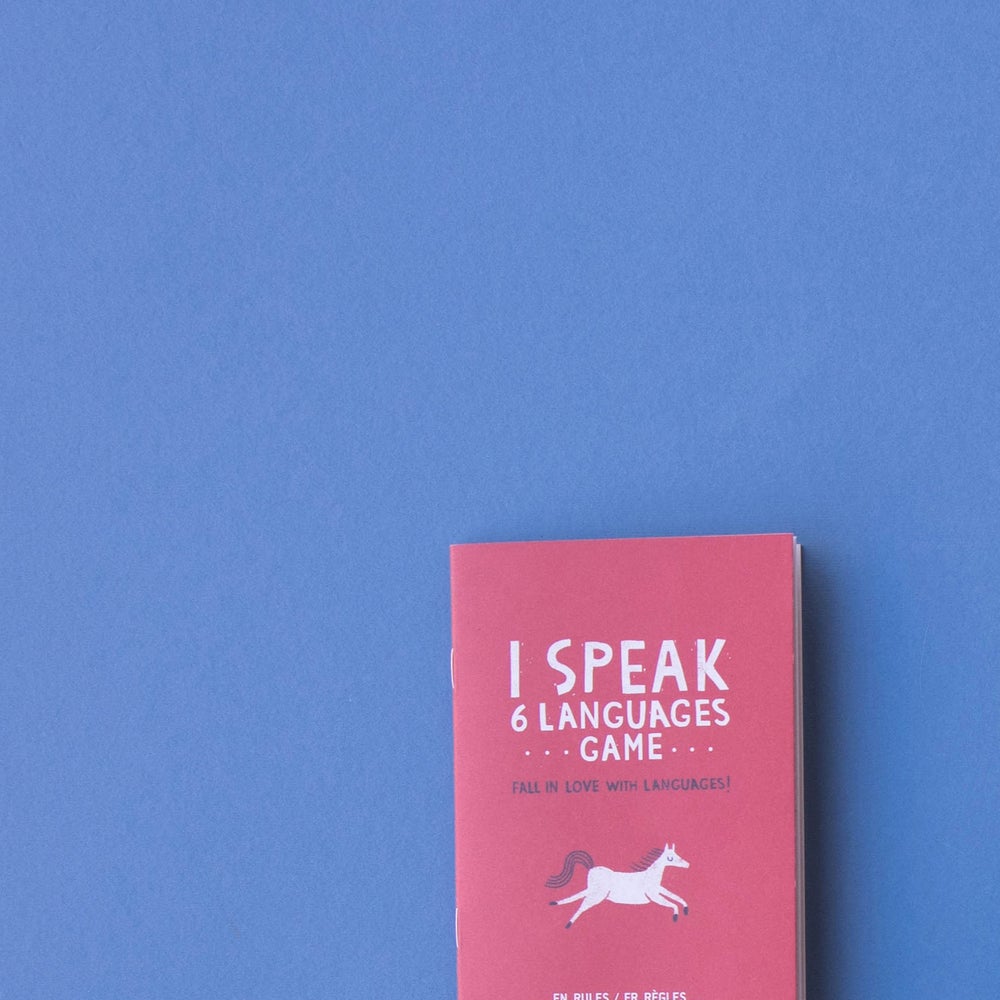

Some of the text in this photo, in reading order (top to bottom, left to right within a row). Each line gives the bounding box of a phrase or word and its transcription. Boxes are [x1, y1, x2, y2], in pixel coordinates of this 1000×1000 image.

[510, 638, 730, 698] I SPEAK
[510, 698, 730, 732] 6 LANGUAGES
[580, 732, 663, 762] GAME
[512, 775, 731, 794] FALL IN LOVE WITH LANGUAGES!
